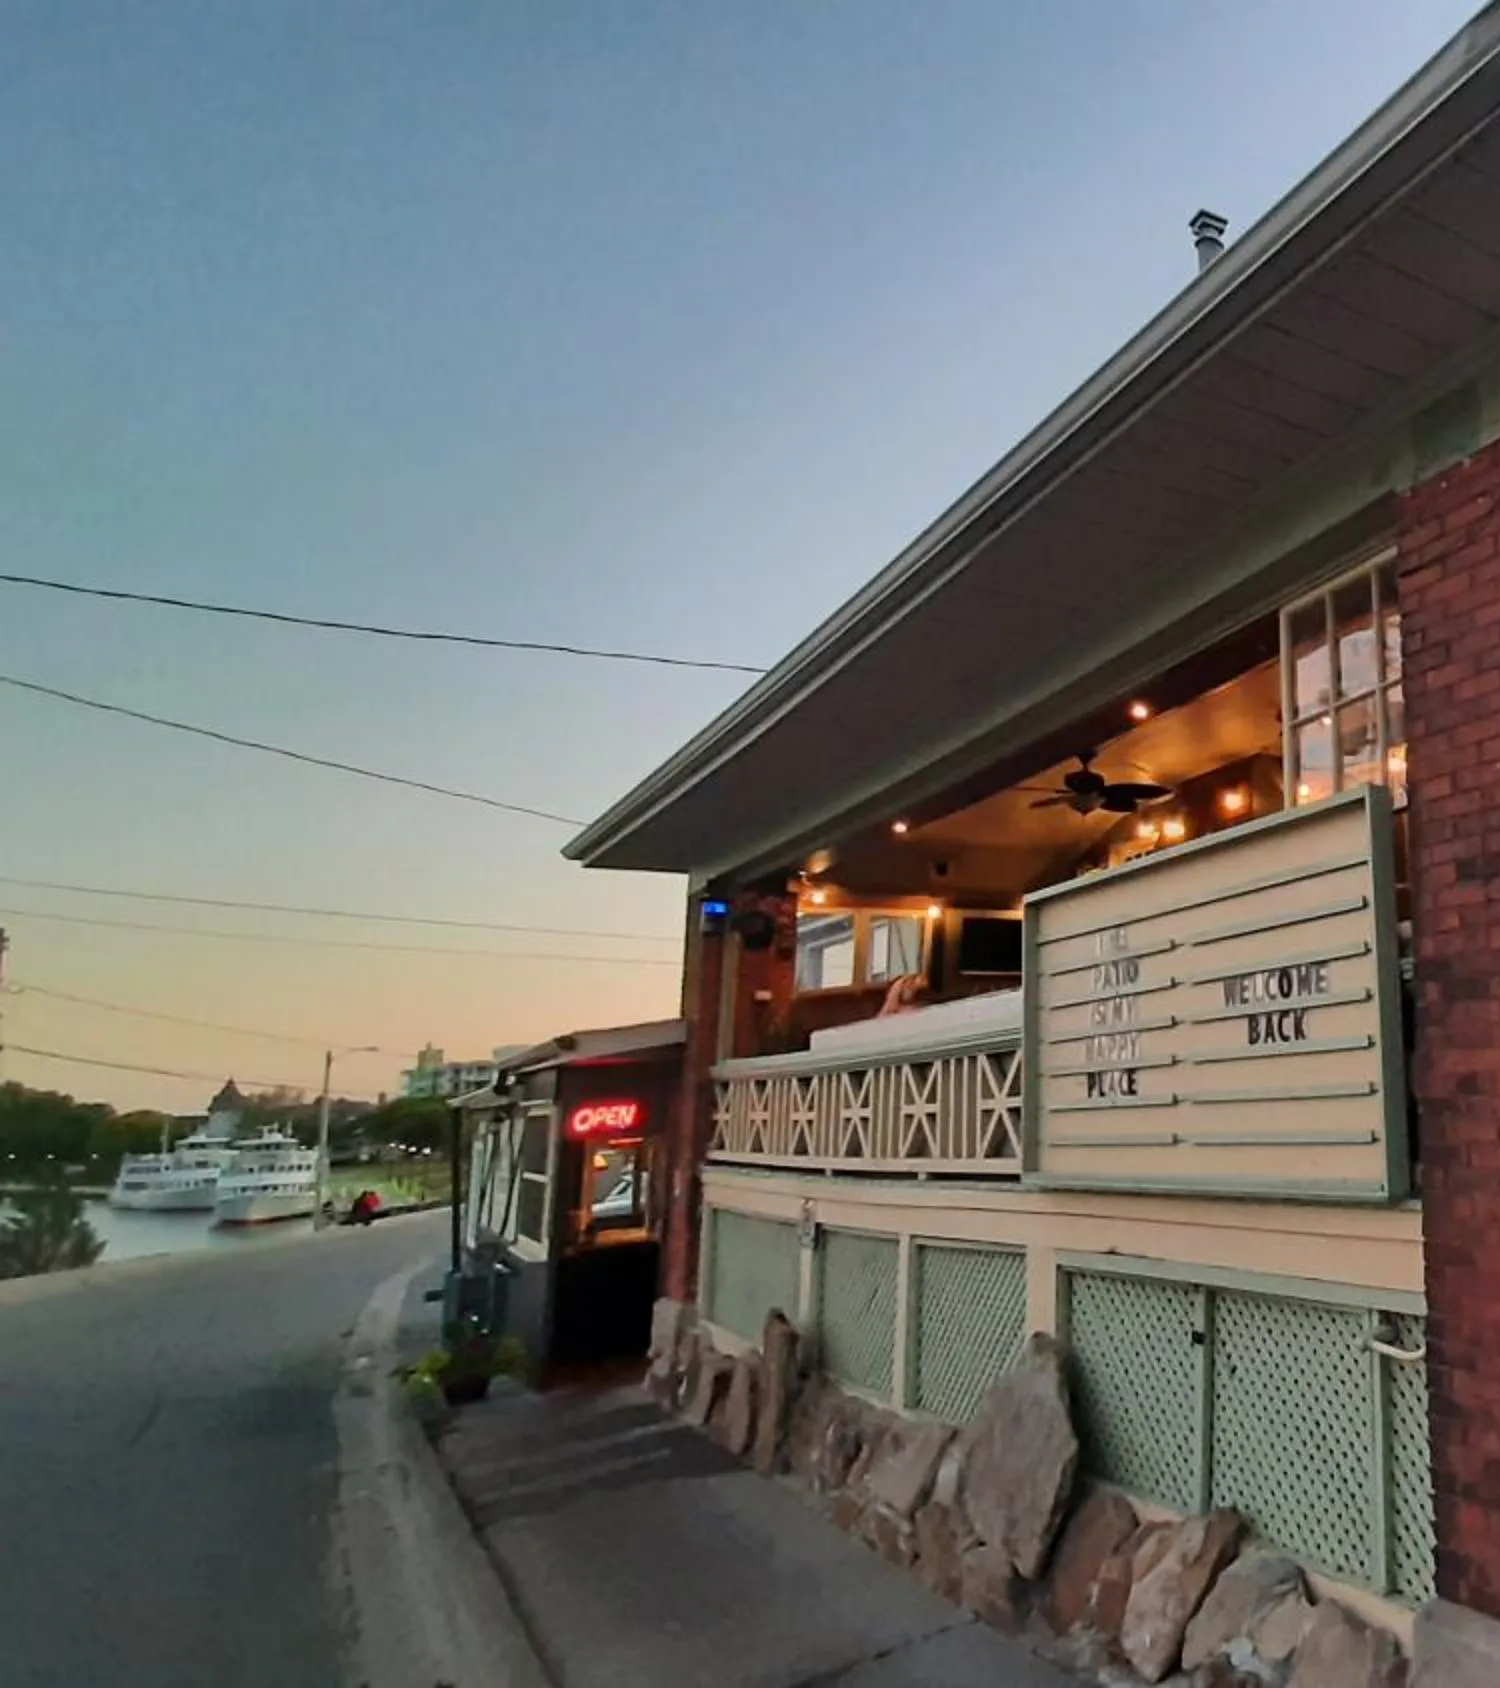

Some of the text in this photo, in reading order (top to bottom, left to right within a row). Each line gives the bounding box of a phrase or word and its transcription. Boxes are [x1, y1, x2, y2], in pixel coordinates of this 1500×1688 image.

[1093, 958, 1139, 990] PATIO
[1222, 962, 1329, 1007] WELCOME
[1247, 1010, 1308, 1046] BACK
[1085, 1032, 1140, 1063] HAPPY
[1087, 1068, 1138, 1098] PLACE
[572, 1104, 637, 1132] OPEN
